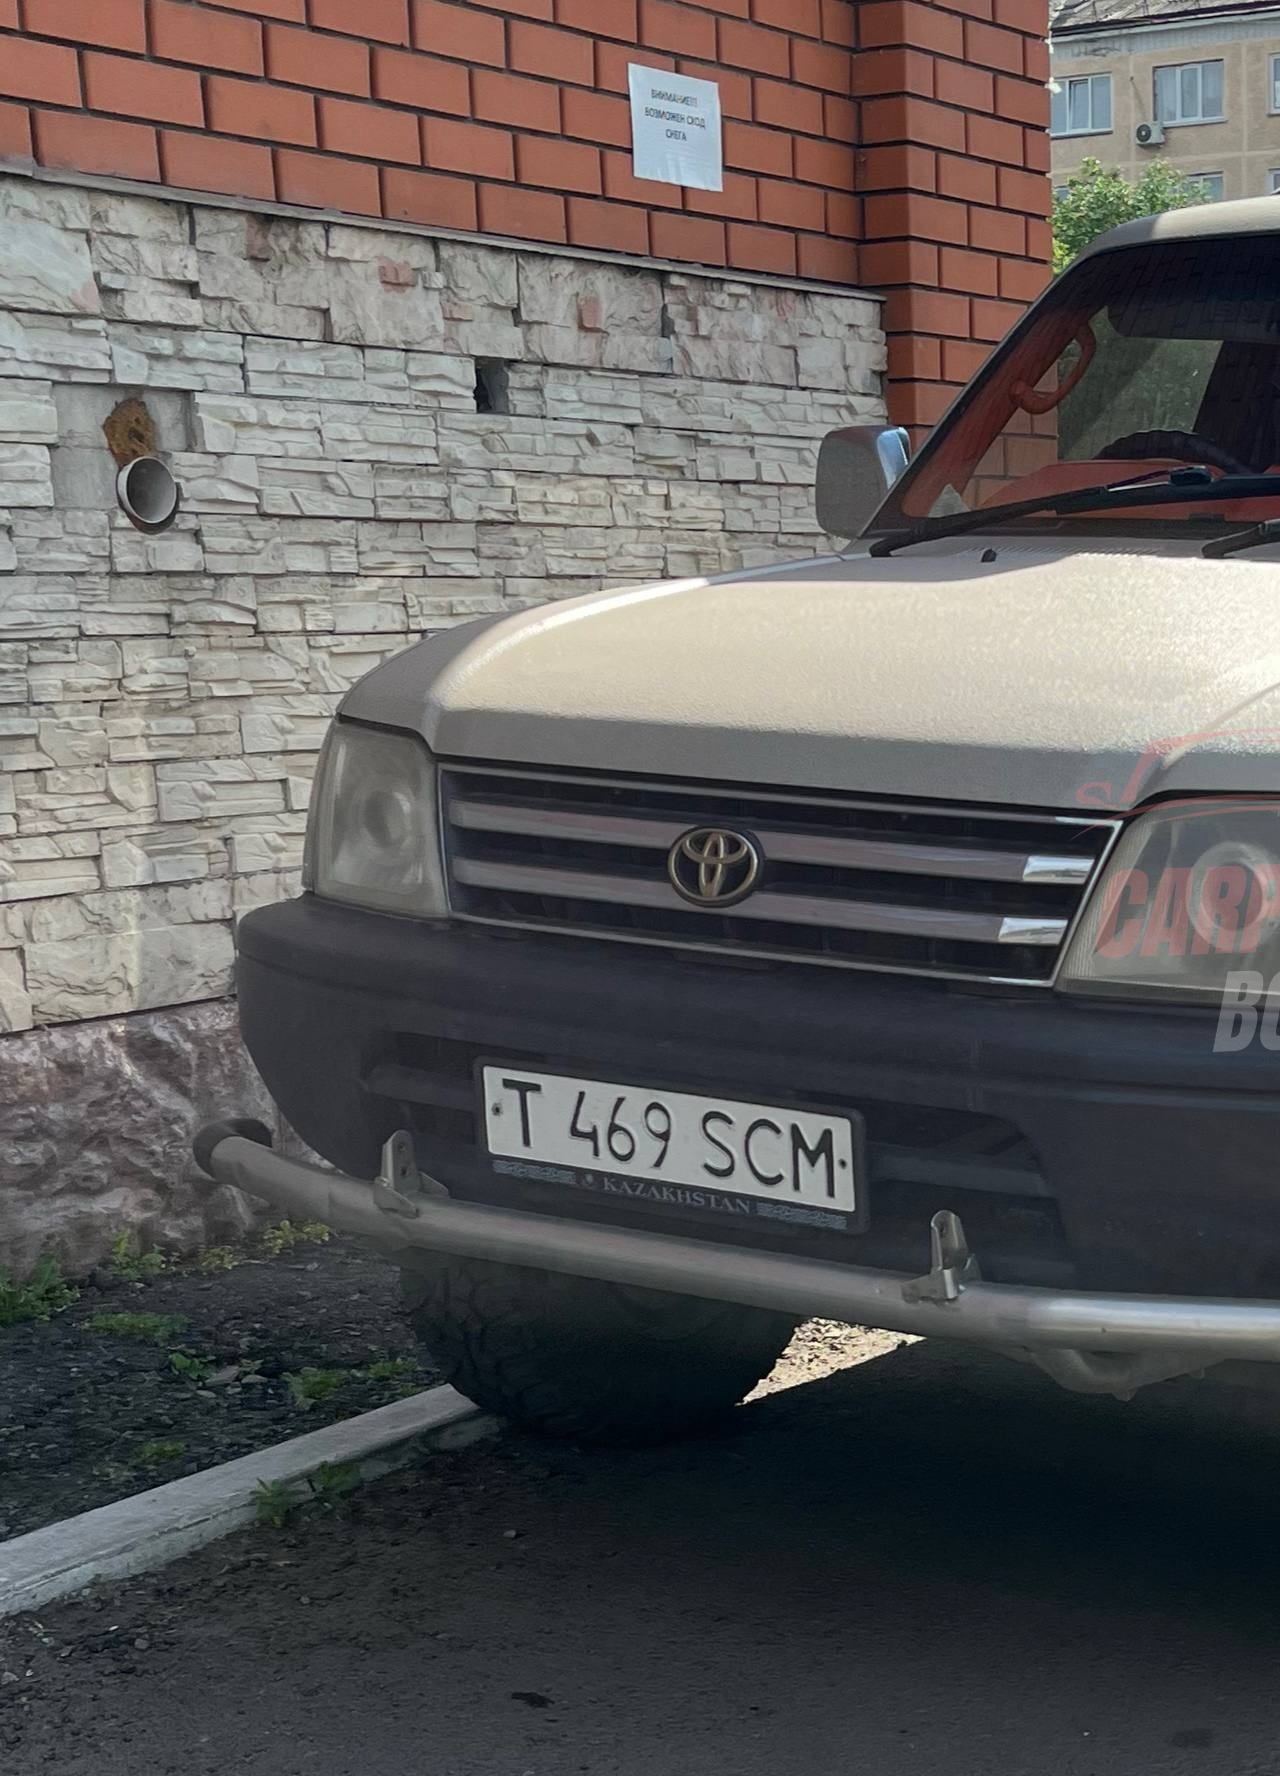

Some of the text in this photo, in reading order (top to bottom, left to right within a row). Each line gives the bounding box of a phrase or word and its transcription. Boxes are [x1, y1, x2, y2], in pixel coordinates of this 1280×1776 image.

[645, 106, 685, 124] ВОЗМОЖЕН
[502, 1077, 836, 1199] T 469 SCM
[603, 1176, 752, 1216] KAZAKHSTAN
